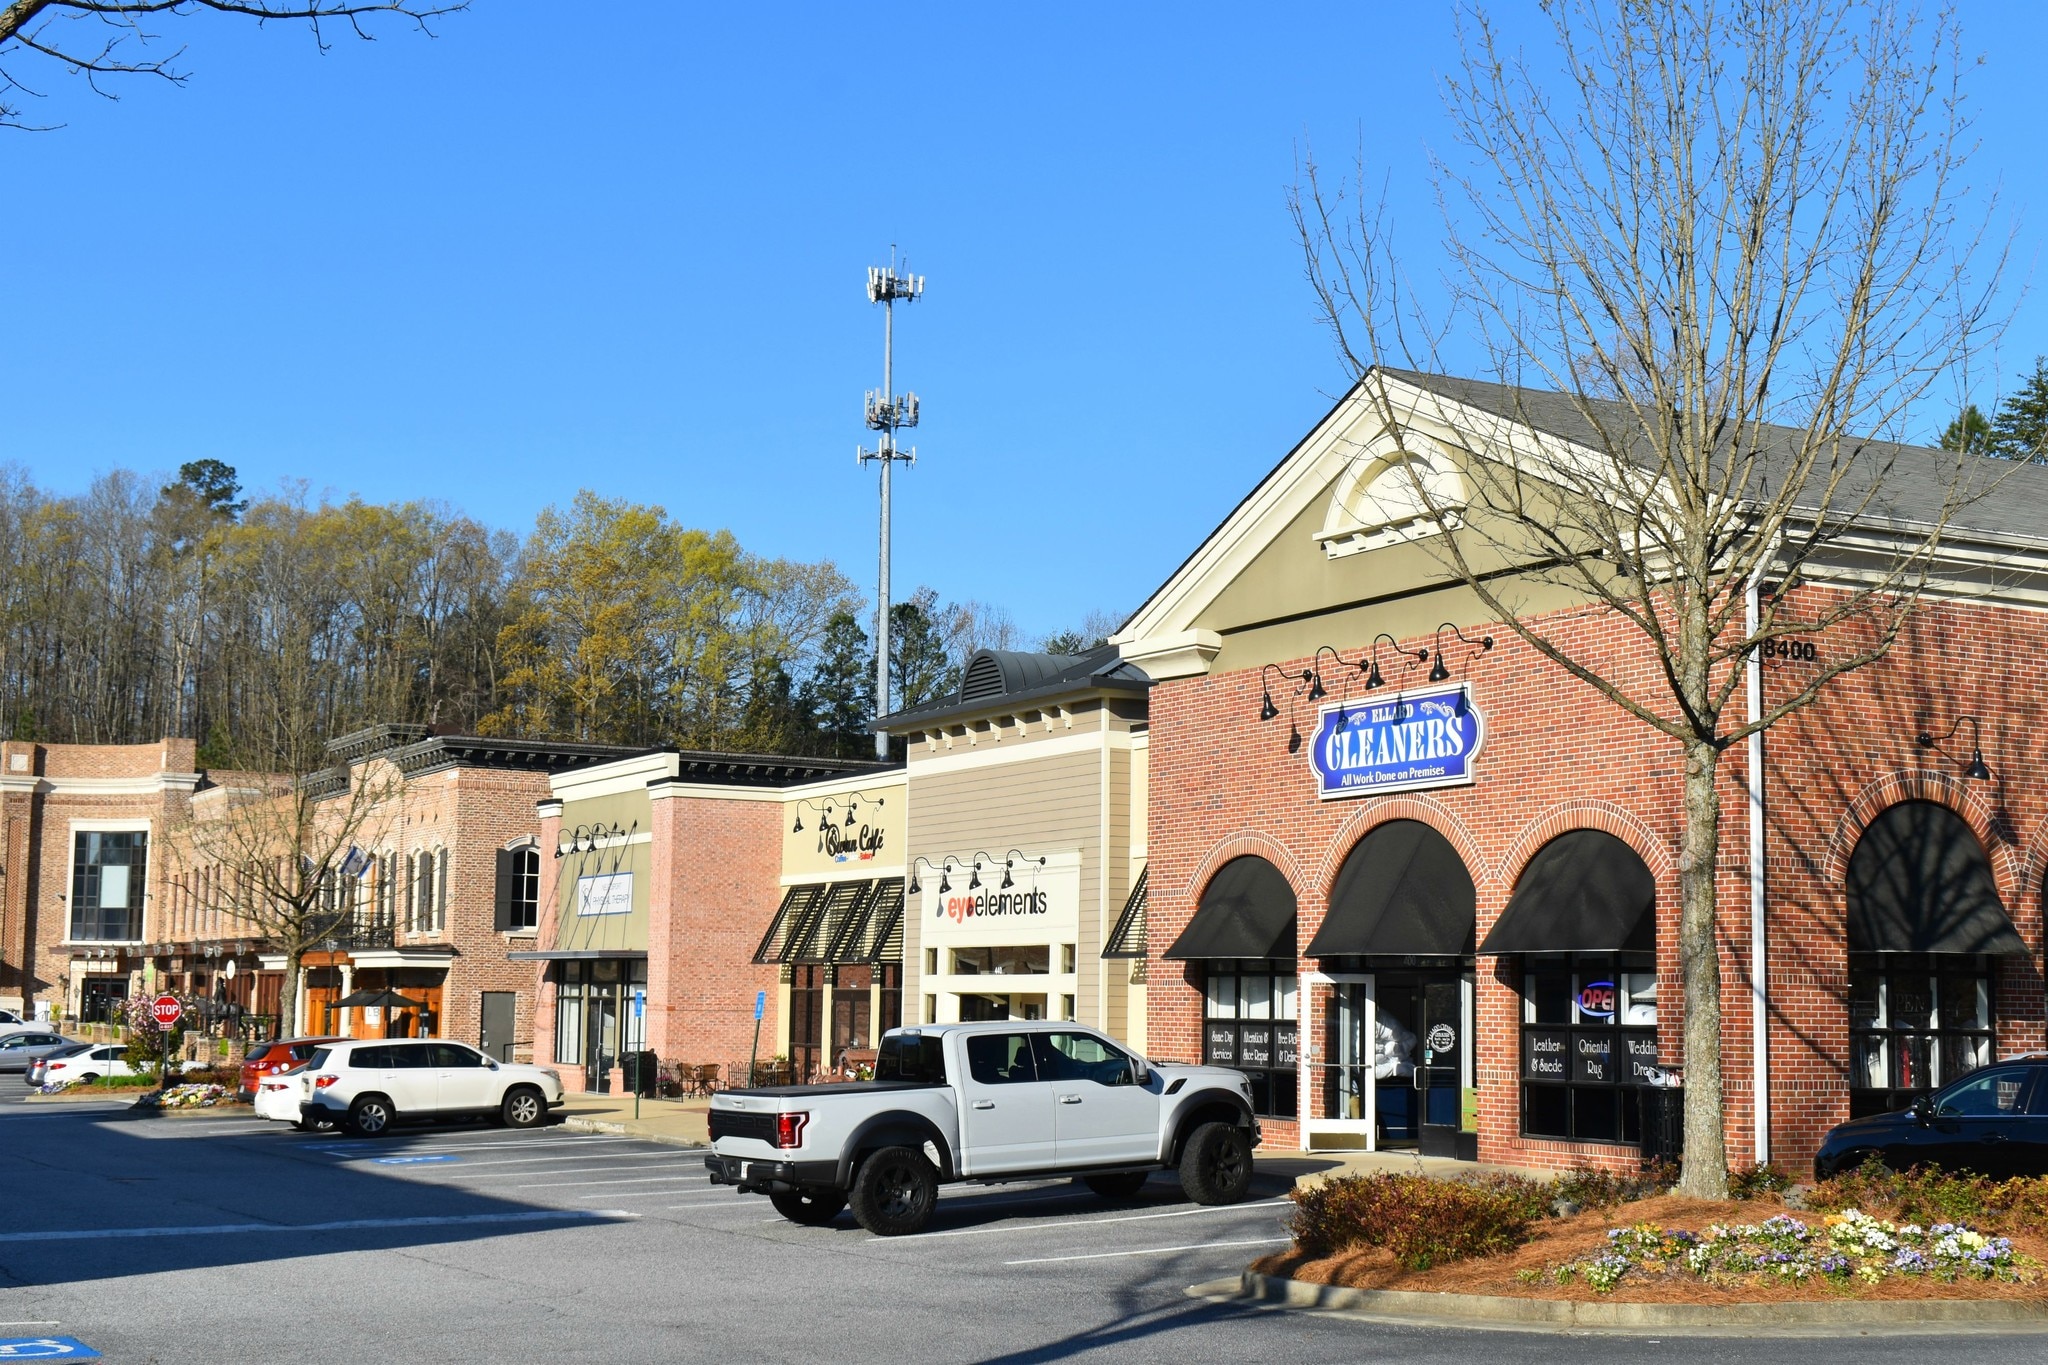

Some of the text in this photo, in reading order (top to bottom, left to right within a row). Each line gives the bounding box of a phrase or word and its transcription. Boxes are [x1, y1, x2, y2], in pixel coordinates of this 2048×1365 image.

[1764, 638, 1815, 661] 8400
[1371, 703, 1414, 723] ELLARD
[1325, 716, 1464, 771] CLEANERS
[1341, 765, 1445, 787] All Work Done on Premises
[859, 824, 884, 857] Café
[154, 1005, 179, 1015] STOP
[1211, 1030, 1234, 1046] Same Day
[1533, 1038, 1561, 1052] Leather
[1212, 1048, 1233, 1060] Services
[1578, 1039, 1610, 1054] Oriental
[1627, 1040, 1657, 1055] Weddin
[1242, 1048, 1269, 1065] Shoe Repair
[1539, 1058, 1563, 1073] Suede
[1587, 1060, 1603, 1079] Rug
